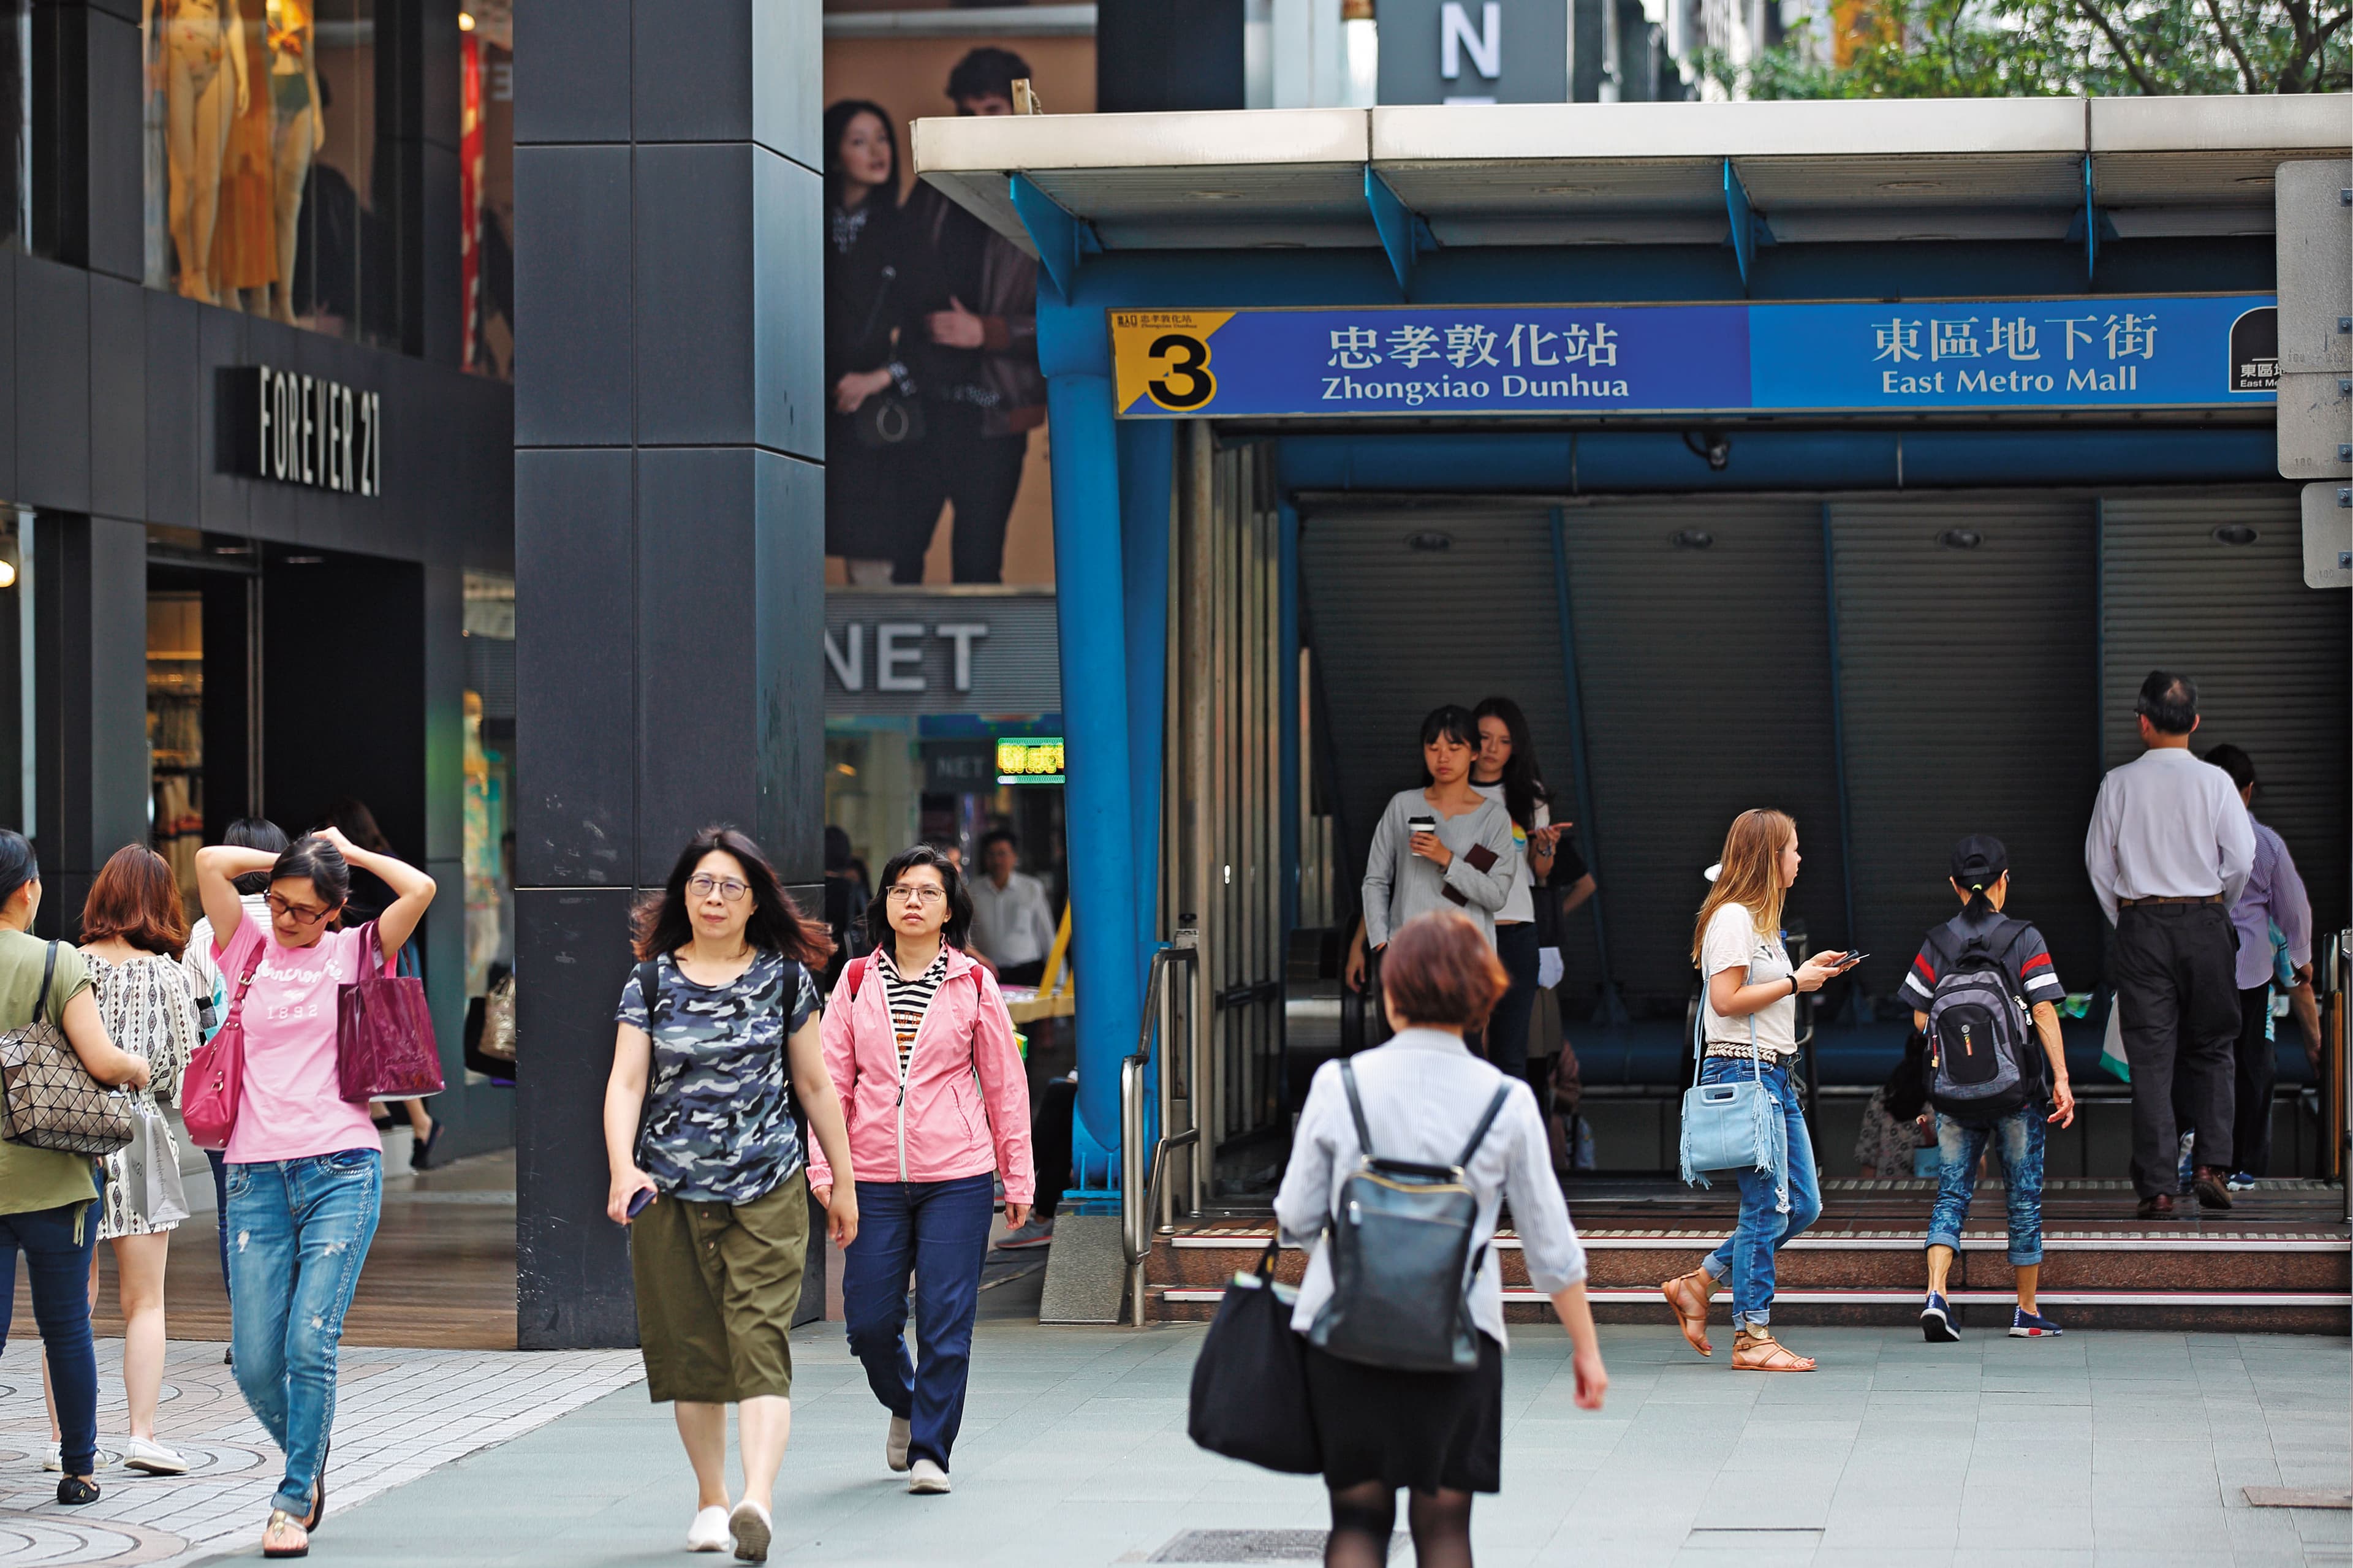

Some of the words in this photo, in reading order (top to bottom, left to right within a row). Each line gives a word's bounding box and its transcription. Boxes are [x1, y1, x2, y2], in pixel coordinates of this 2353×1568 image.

[1442, 2, 1500, 105] N
[1327, 322, 1619, 369] 忠孝敦化站
[1871, 313, 2158, 363] 東區地下街
[1148, 335, 1212, 407] 3
[1321, 374, 1490, 406] Zhongxiao
[1502, 373, 1629, 398] Dunhua
[1882, 371, 1945, 394] East
[1957, 369, 2054, 393] Metro
[2066, 365, 2137, 392] Mall
[260, 365, 354, 494] FOREVER
[361, 390, 381, 498] 21
[825, 624, 988, 691] NET
